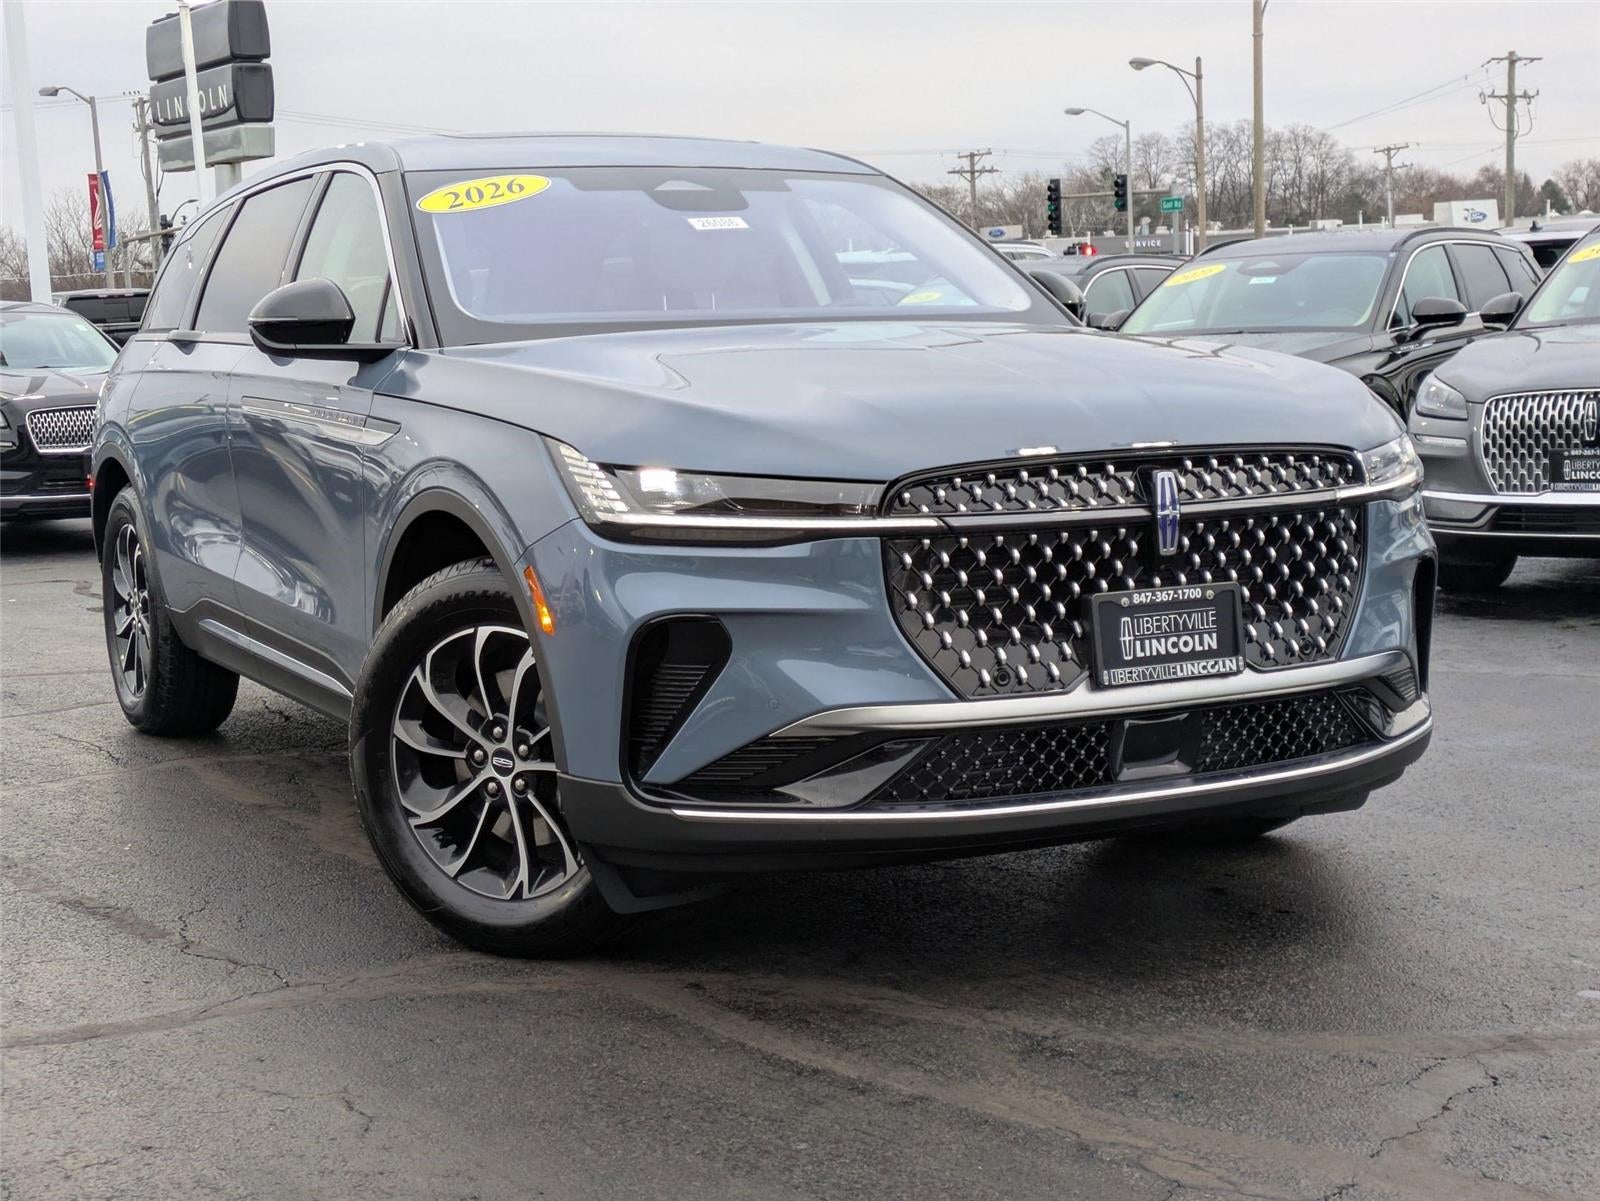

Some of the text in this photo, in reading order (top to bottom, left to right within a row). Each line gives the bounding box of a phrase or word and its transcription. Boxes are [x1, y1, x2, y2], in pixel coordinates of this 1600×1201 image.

[156, 84, 228, 122] LINOLN
[444, 178, 525, 209] 2026
[1571, 460, 1600, 470] LIBERTY
[1571, 471, 1600, 480] LINCO
[1133, 588, 1202, 604] 847-367-1700
[1134, 611, 1217, 635] LIBERTYVILLE
[1135, 633, 1218, 657] LINCOLN
